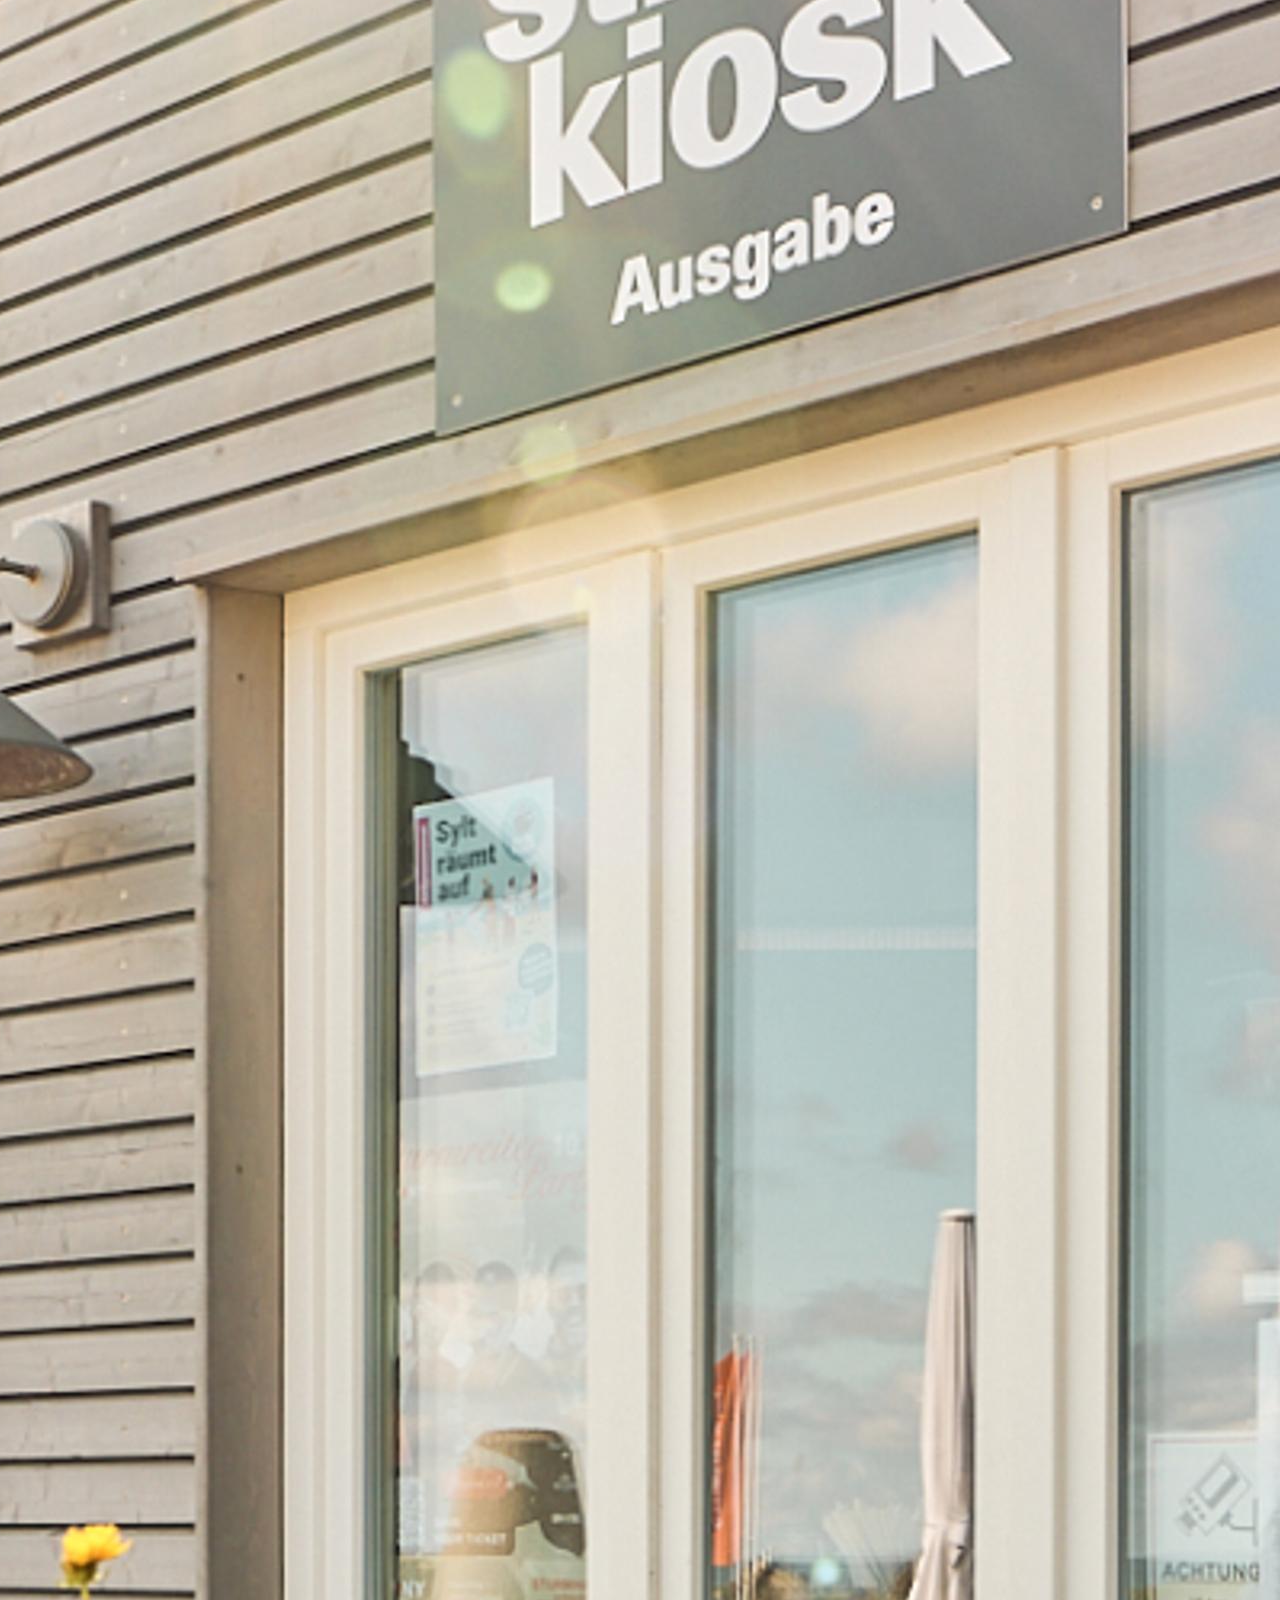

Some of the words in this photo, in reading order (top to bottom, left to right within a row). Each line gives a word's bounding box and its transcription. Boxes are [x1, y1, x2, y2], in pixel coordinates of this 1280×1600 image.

[609, 191, 896, 325] Ausgabe
[435, 814, 477, 847] Sylt
[1161, 1561, 1260, 1582] ACHTUNG
